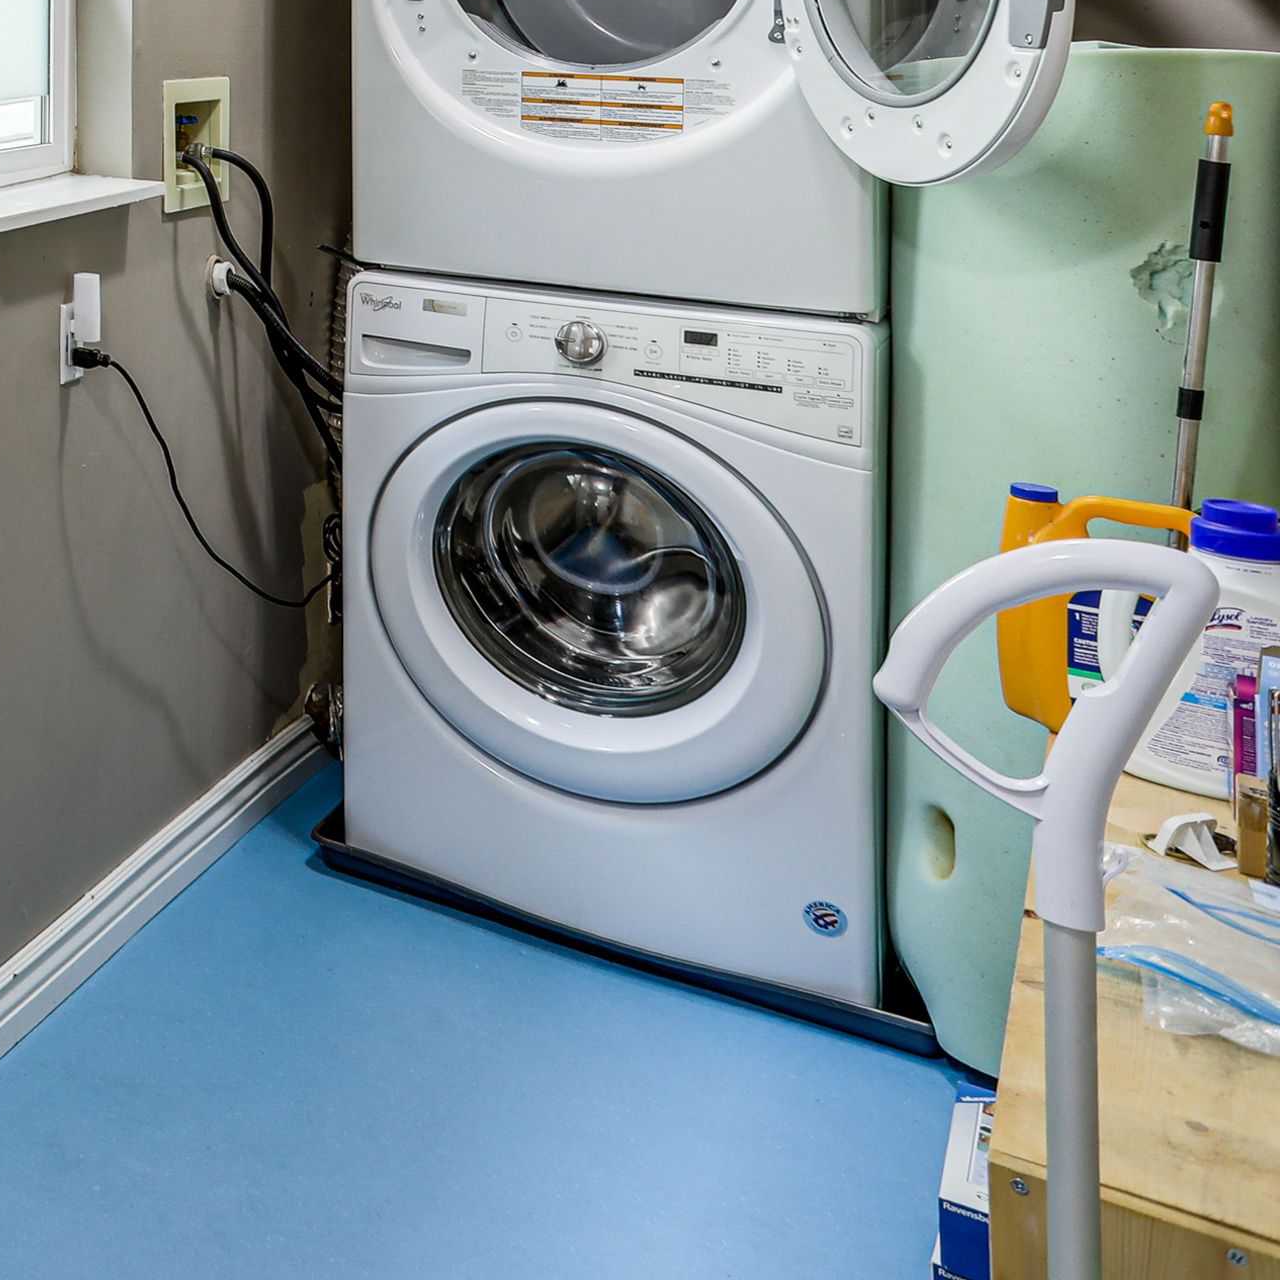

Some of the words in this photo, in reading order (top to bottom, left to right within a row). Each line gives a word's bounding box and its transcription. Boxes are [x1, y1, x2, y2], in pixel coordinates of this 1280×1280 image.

[359, 291, 402, 312] Whirlpool
[1210, 608, 1243, 625] Lysol
[804, 900, 840, 917] AMERICA
